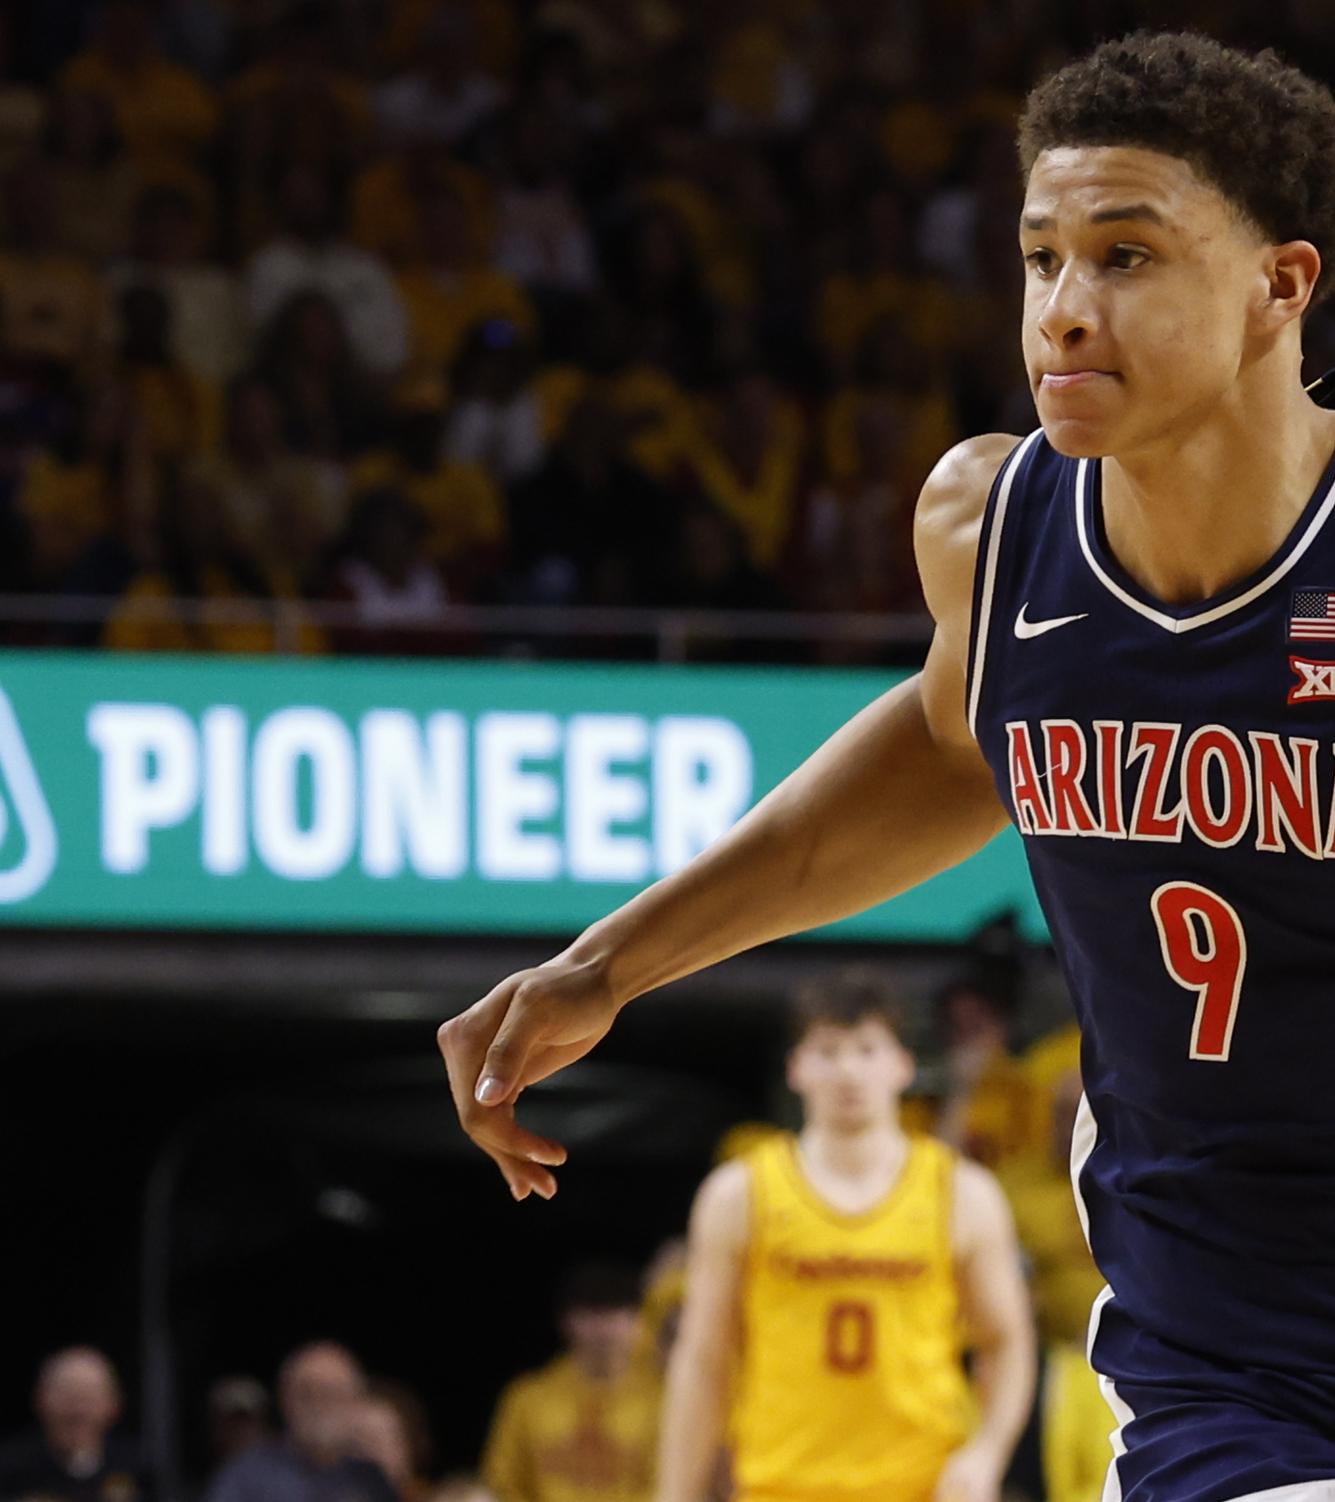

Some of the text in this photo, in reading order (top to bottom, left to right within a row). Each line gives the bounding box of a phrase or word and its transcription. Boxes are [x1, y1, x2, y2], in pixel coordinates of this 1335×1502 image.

[87, 703, 753, 881] PIONEER
[1150, 880, 1247, 1062] 9
[827, 1301, 876, 1375] 0
